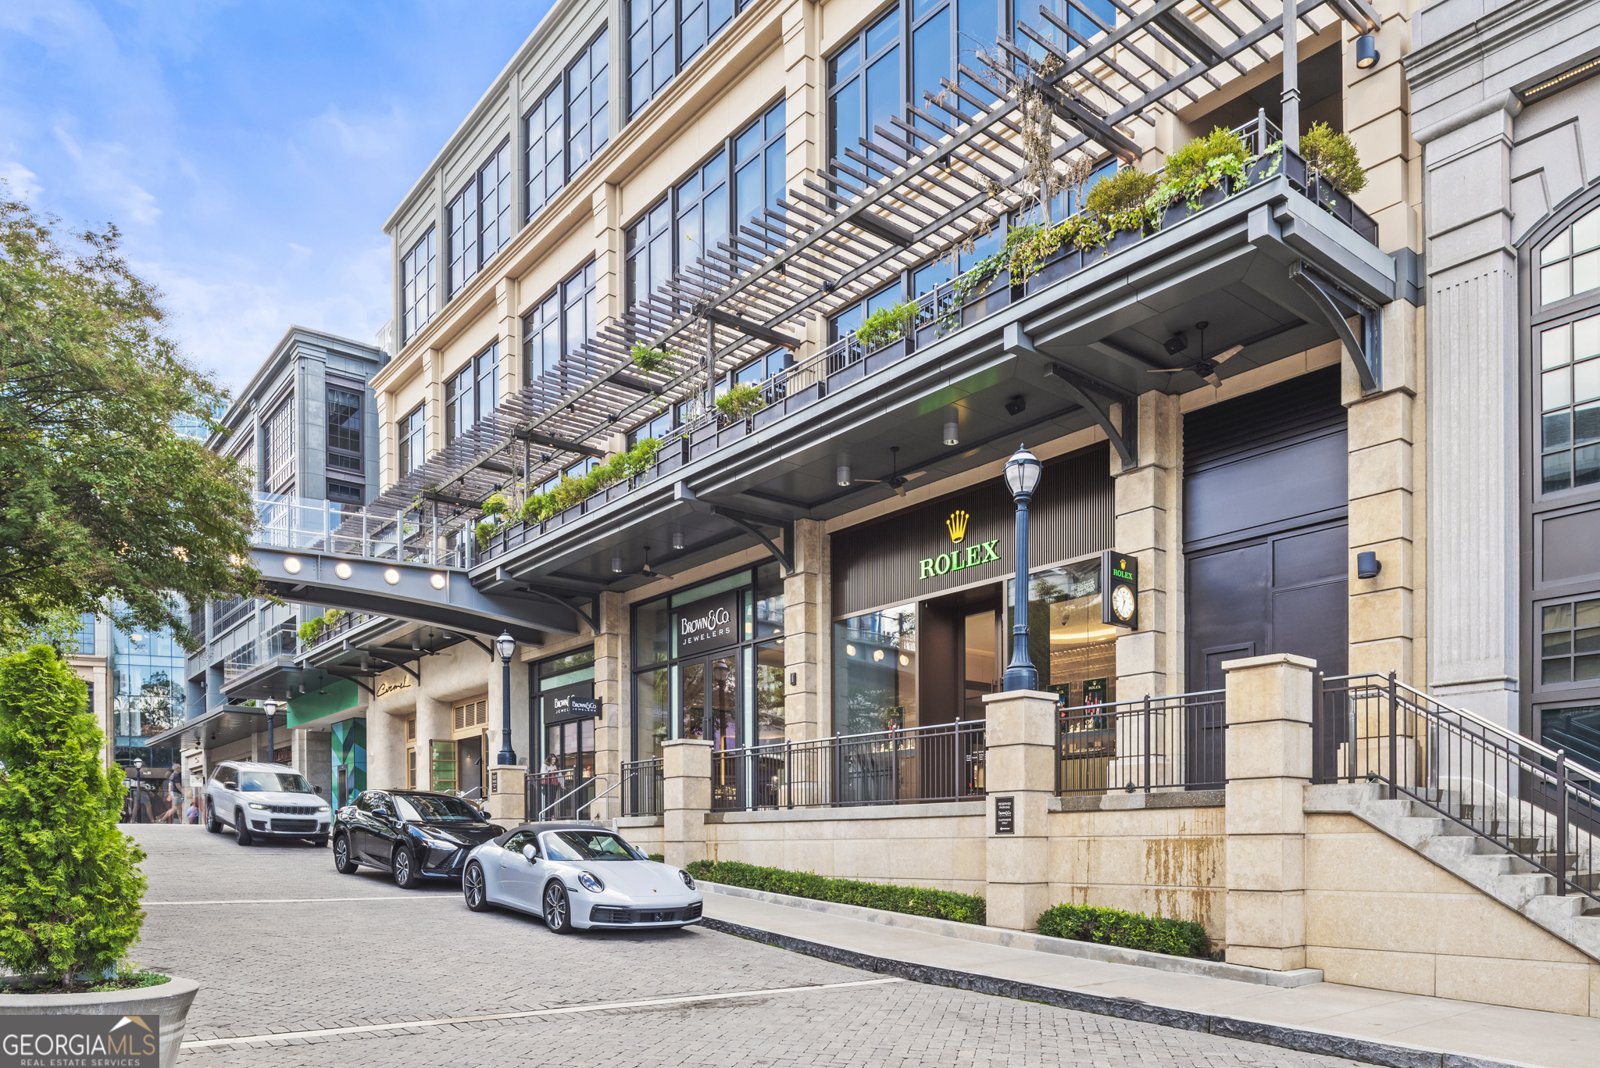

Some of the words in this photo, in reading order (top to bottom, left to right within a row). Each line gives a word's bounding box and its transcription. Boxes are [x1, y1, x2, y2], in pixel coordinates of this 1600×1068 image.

[920, 539, 1000, 580] ROLEX
[1113, 569, 1133, 580] ROLEX
[682, 627, 731, 645] JEWELERS
